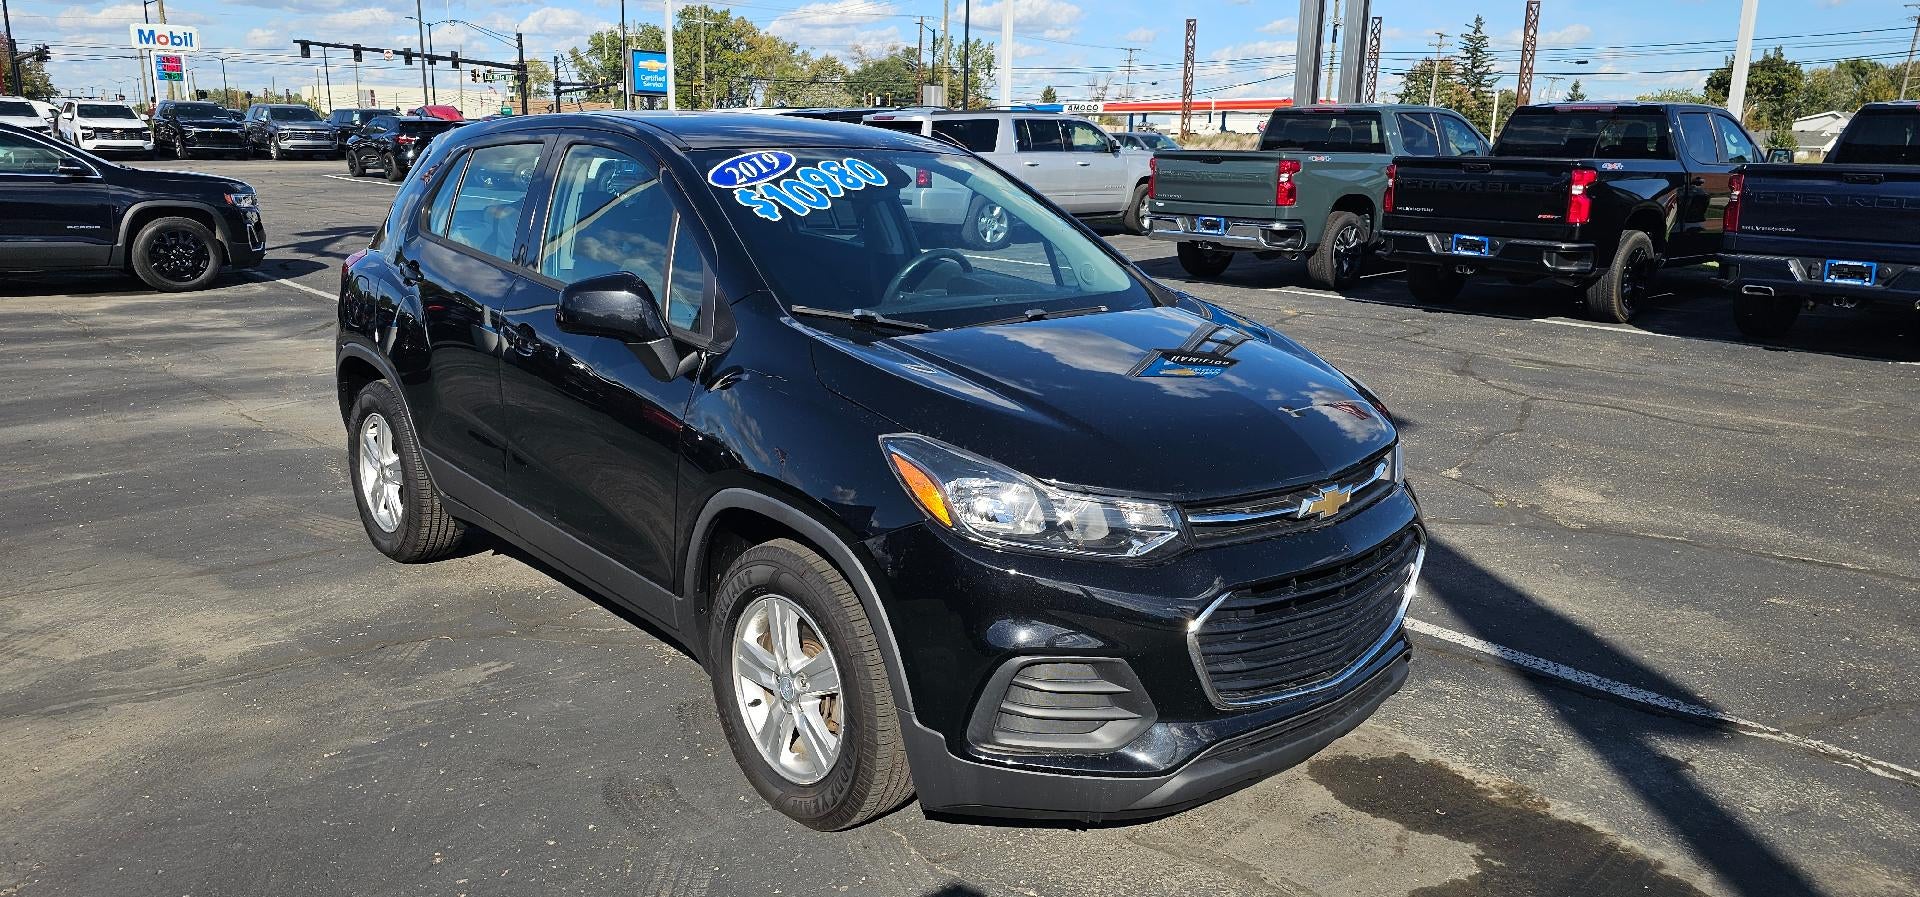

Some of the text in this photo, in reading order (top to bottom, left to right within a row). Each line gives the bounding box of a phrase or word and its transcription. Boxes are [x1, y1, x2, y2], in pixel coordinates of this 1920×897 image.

[137, 28, 194, 47] Mobil
[641, 74, 666, 82] Certified
[642, 80, 664, 88] Service
[725, 152, 780, 185] 2019
[733, 158, 889, 222] $10980
